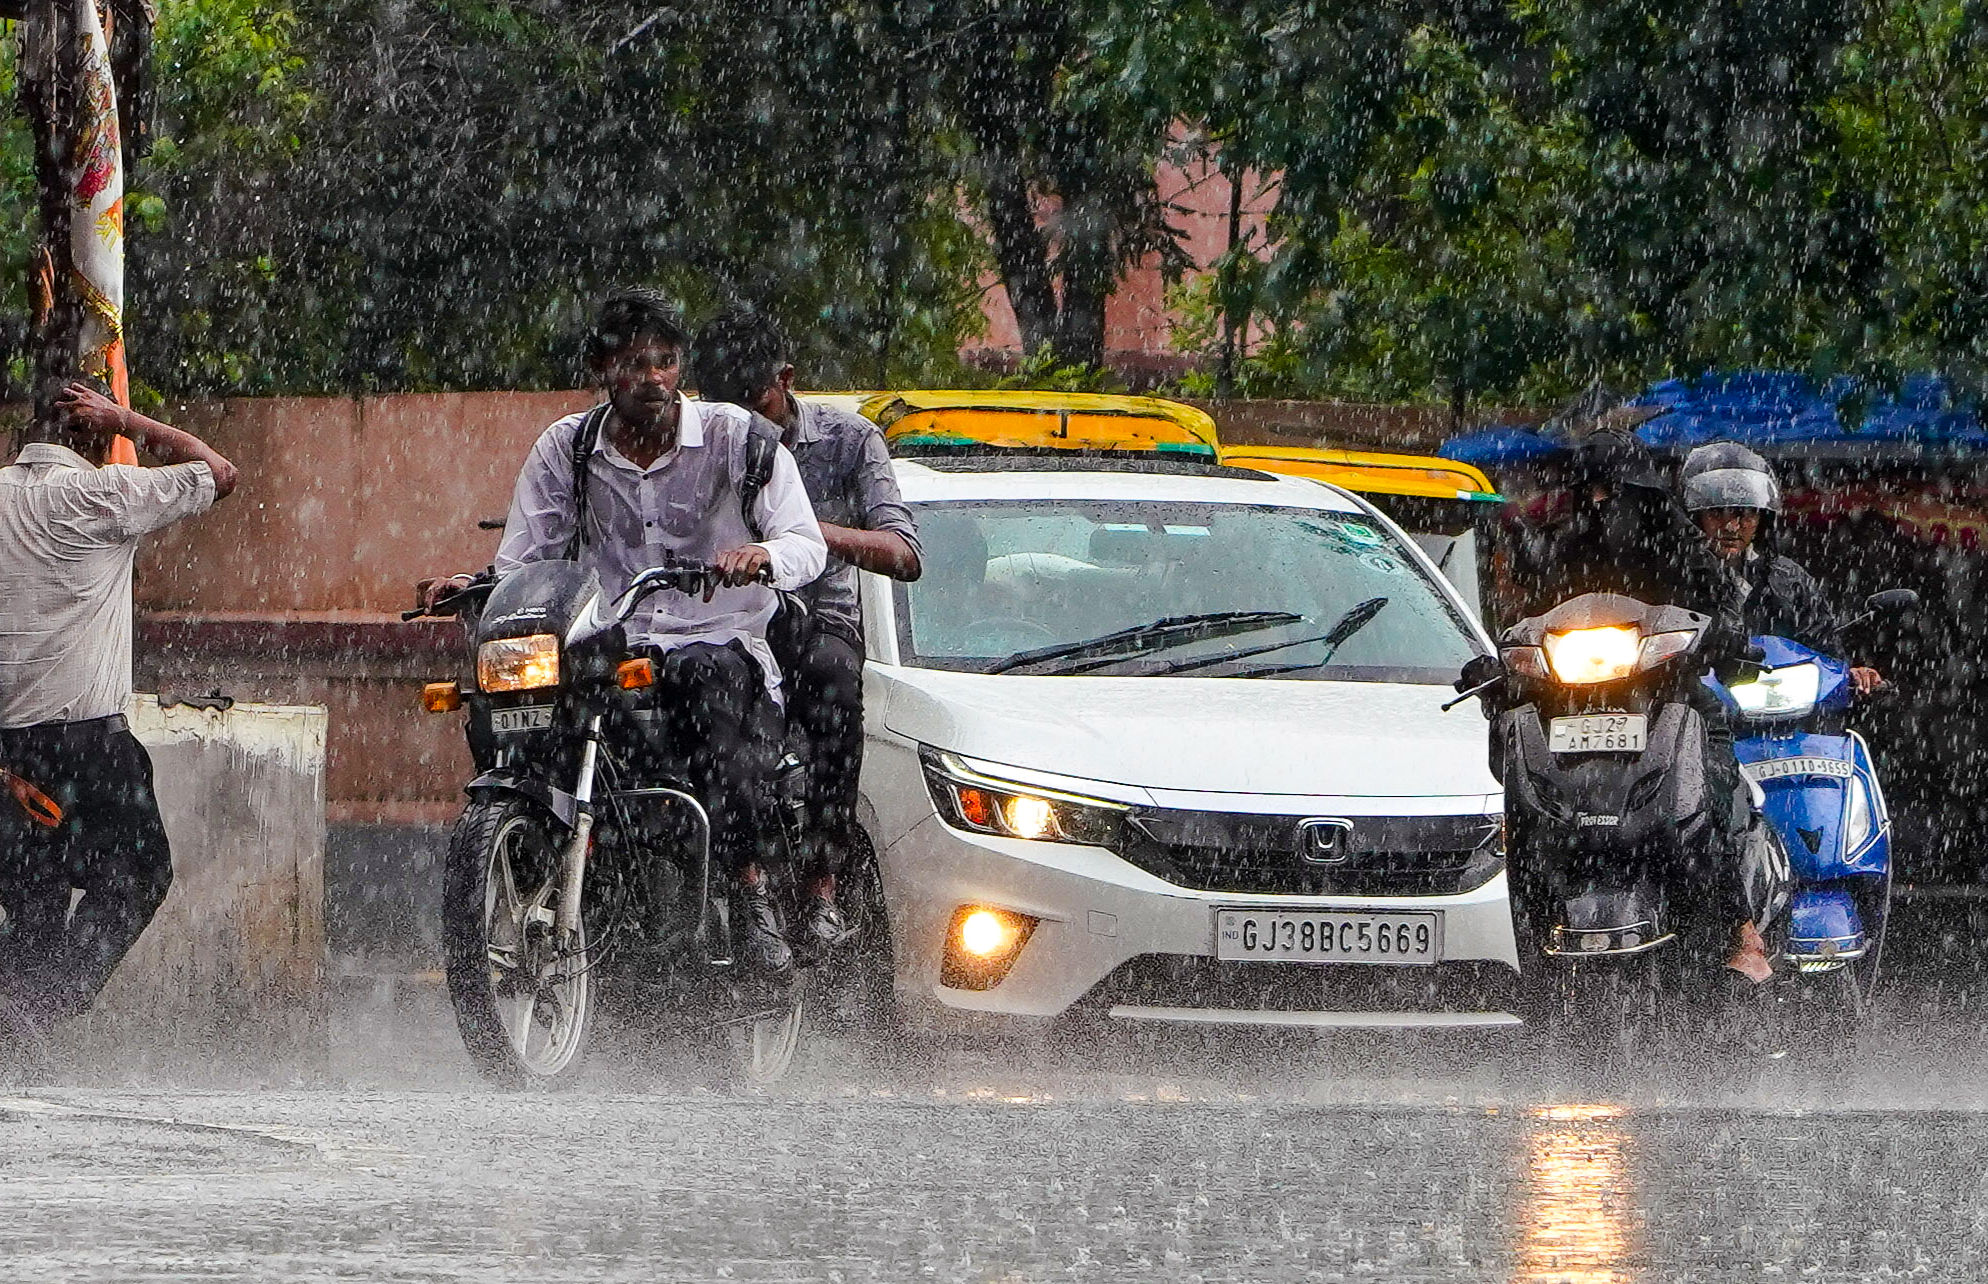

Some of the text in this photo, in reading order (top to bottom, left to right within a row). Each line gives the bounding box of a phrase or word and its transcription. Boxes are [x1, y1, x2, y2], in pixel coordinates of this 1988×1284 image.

[1580, 716, 1628, 734] GJ27
[1568, 733, 1639, 750] AM7681
[1243, 918, 1430, 954] GJ38BC5669
